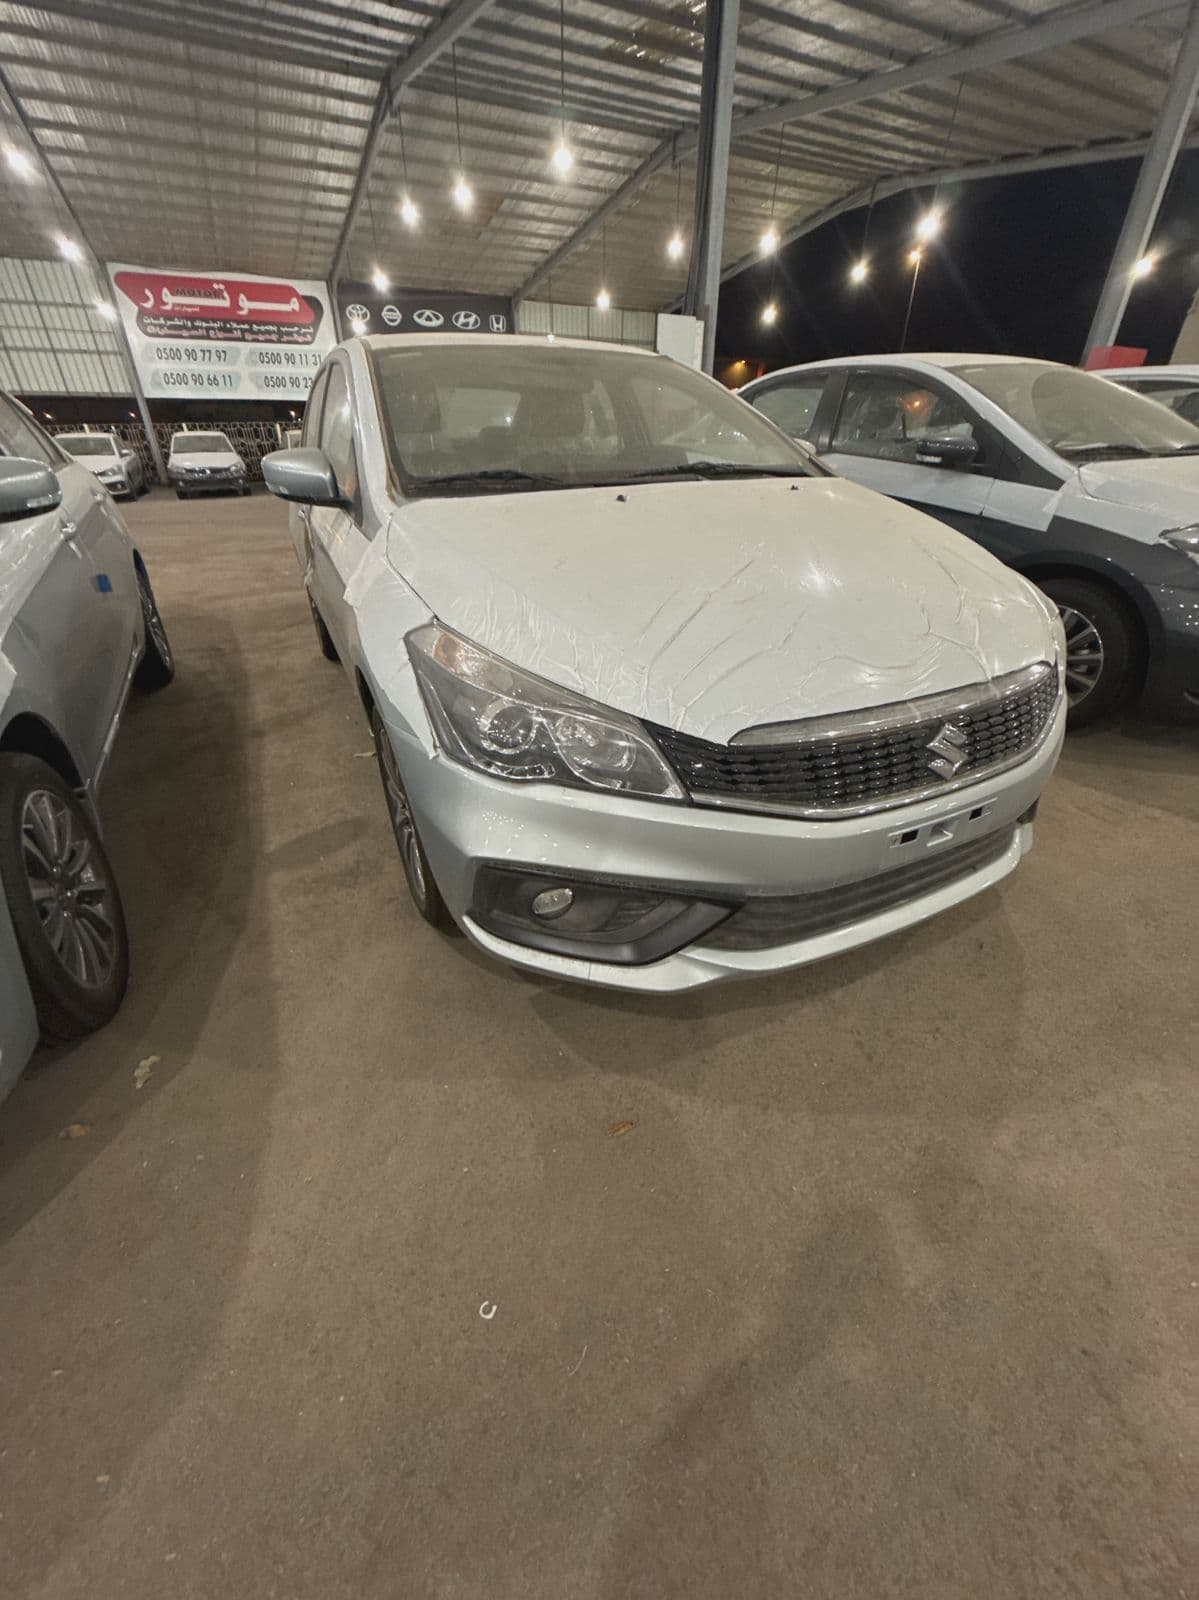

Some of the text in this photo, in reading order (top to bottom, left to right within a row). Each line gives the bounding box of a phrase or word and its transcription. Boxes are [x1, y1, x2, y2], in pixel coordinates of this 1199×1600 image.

[156, 347, 226, 362] 0500 90 77 97
[259, 352, 282, 364] 0500
[284, 352, 296, 365] 90
[299, 354, 308, 366] 11
[163, 372, 232, 387] 0500 90 66 11
[264, 376, 286, 388] 0500
[289, 376, 300, 388] 90
